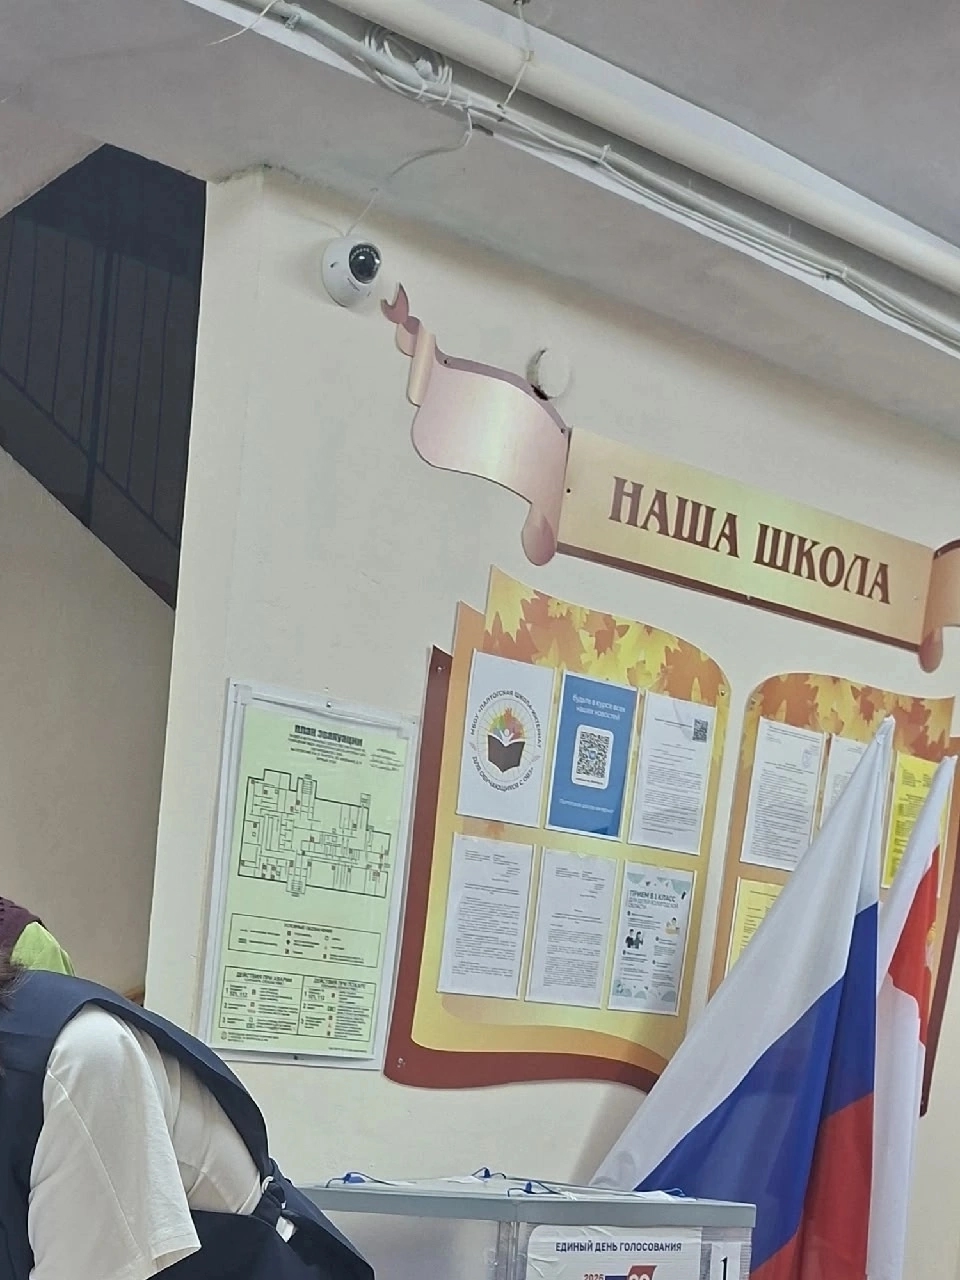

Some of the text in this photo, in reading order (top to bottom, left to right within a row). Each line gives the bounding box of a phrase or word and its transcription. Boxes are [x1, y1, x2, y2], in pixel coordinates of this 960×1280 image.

[608, 475, 891, 606] НАША ШКОЛА
[555, 1240, 682, 1253] ЕДИНЫЙ ДЕНЬ ГОЛОСОВАНИЯ
